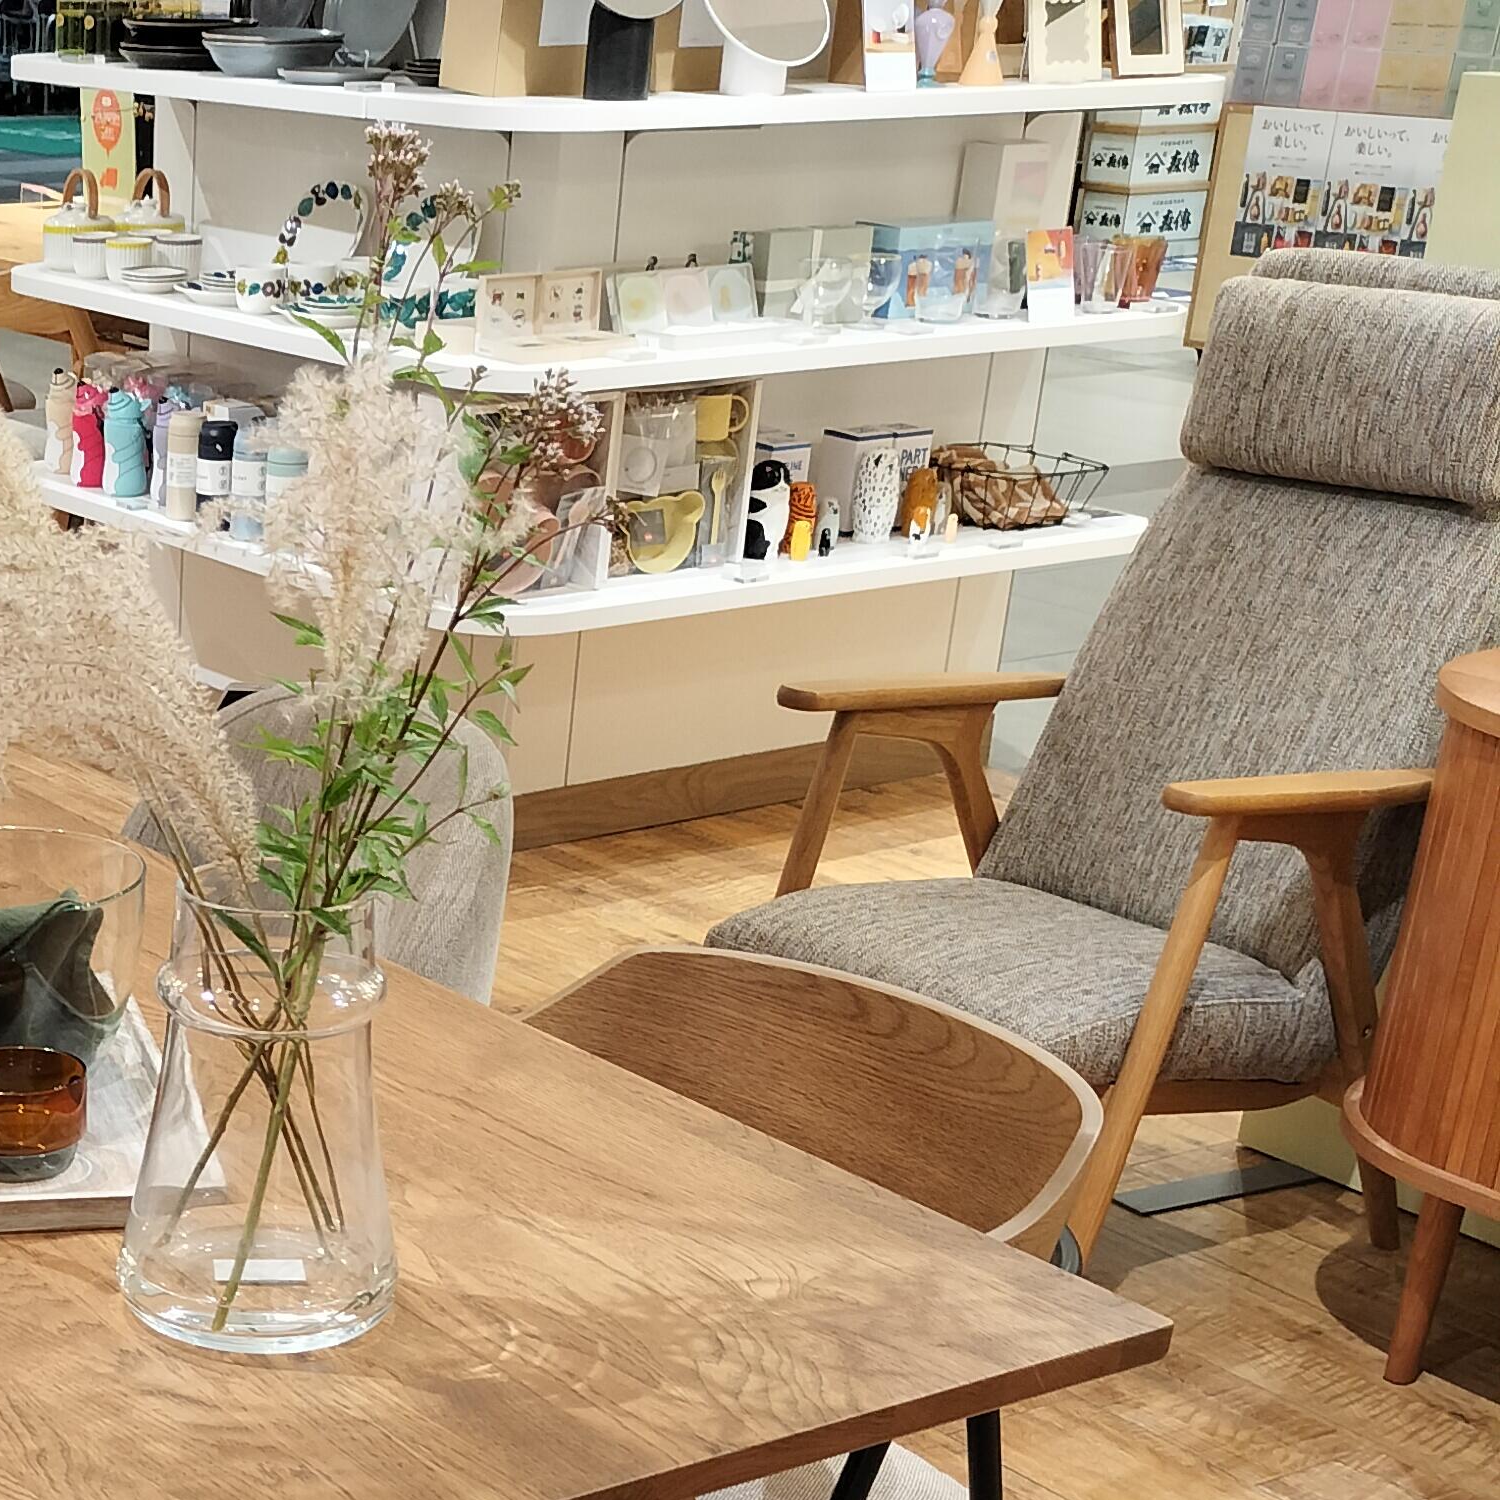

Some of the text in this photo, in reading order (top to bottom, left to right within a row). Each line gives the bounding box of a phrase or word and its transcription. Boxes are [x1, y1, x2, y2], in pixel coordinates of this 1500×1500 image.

[1261, 119, 1324, 136] おいしいって、
[1344, 125, 1410, 142] おいしいって、
[1273, 134, 1307, 151] 楽しい。
[1356, 141, 1393, 158] 楽しい。
[901, 447, 928, 465] PART
